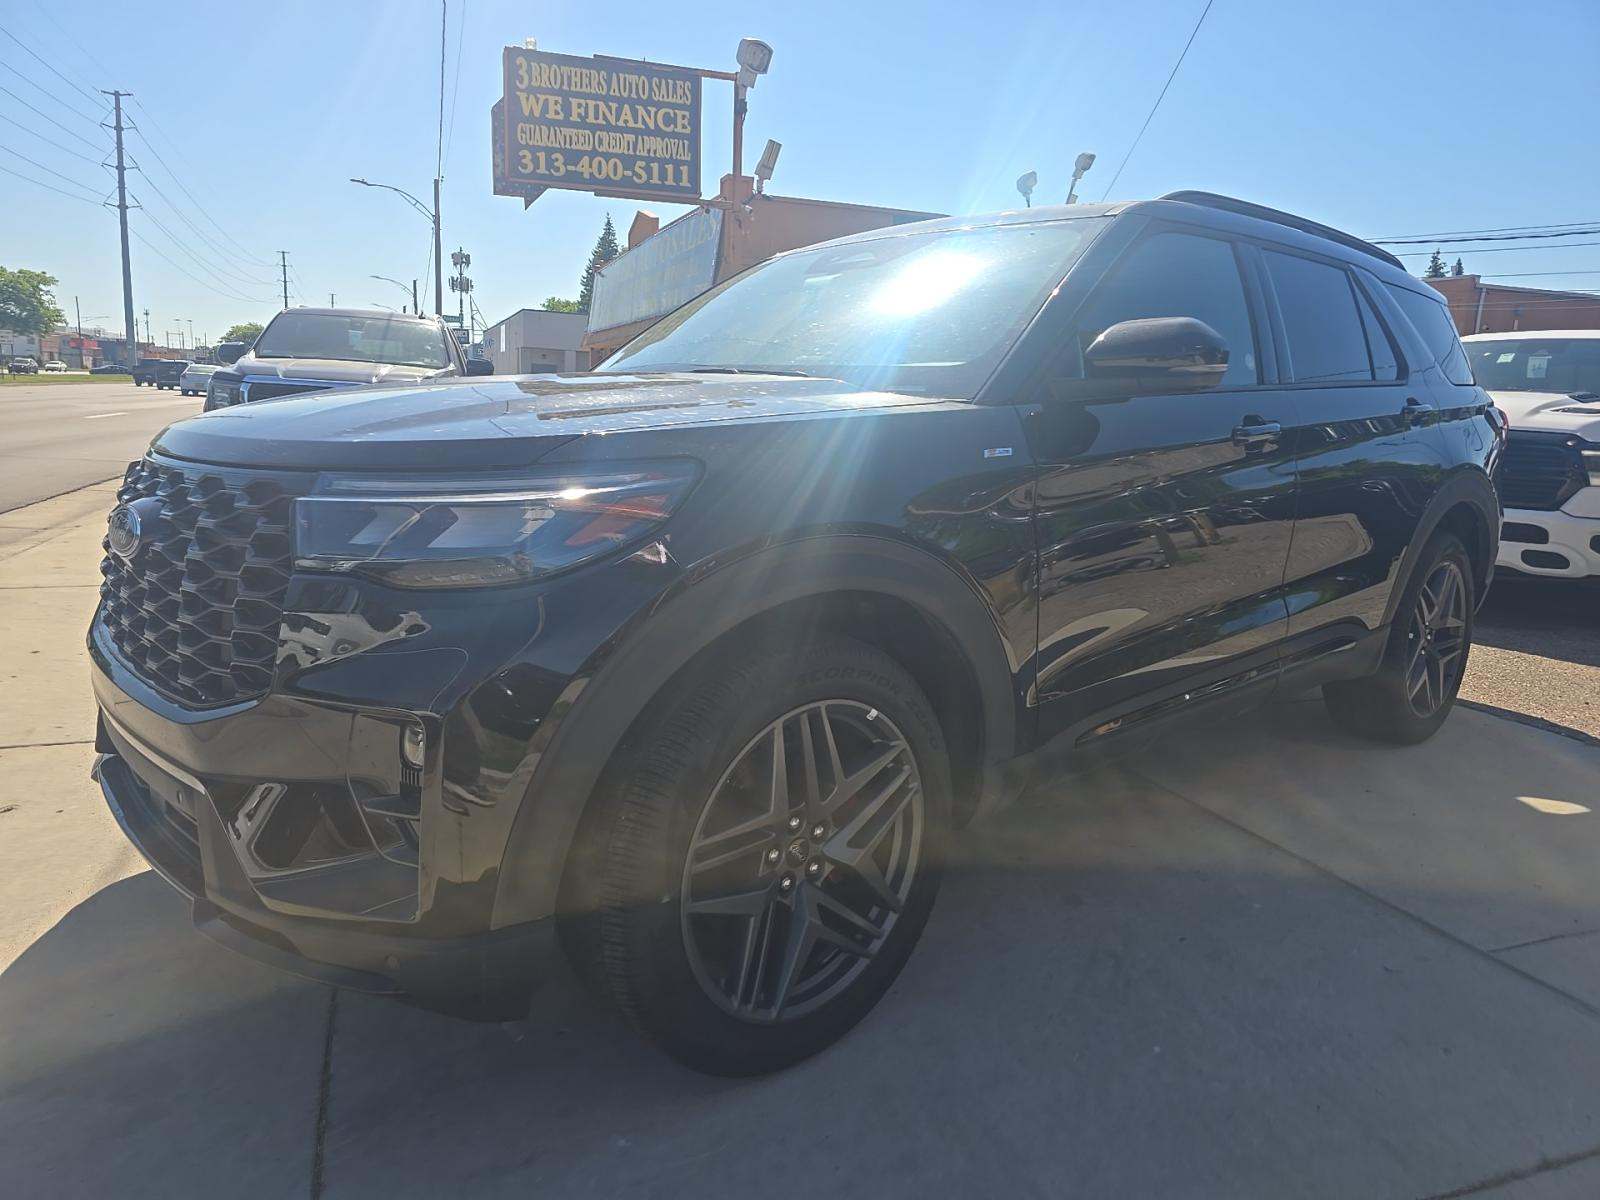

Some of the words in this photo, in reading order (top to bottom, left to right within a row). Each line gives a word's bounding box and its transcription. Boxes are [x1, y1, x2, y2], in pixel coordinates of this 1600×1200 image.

[516, 56, 529, 90] 3
[530, 62, 608, 95] BROTHERS
[610, 72, 649, 100] AUTO
[652, 76, 692, 106] SALES
[516, 91, 565, 120] WE
[569, 97, 691, 134] FINANCE
[517, 122, 593, 150] GUARANTEED
[594, 130, 636, 155] CREDIT
[636, 135, 691, 161] APPROVAL
[518, 149, 692, 187] 313-400-5111
